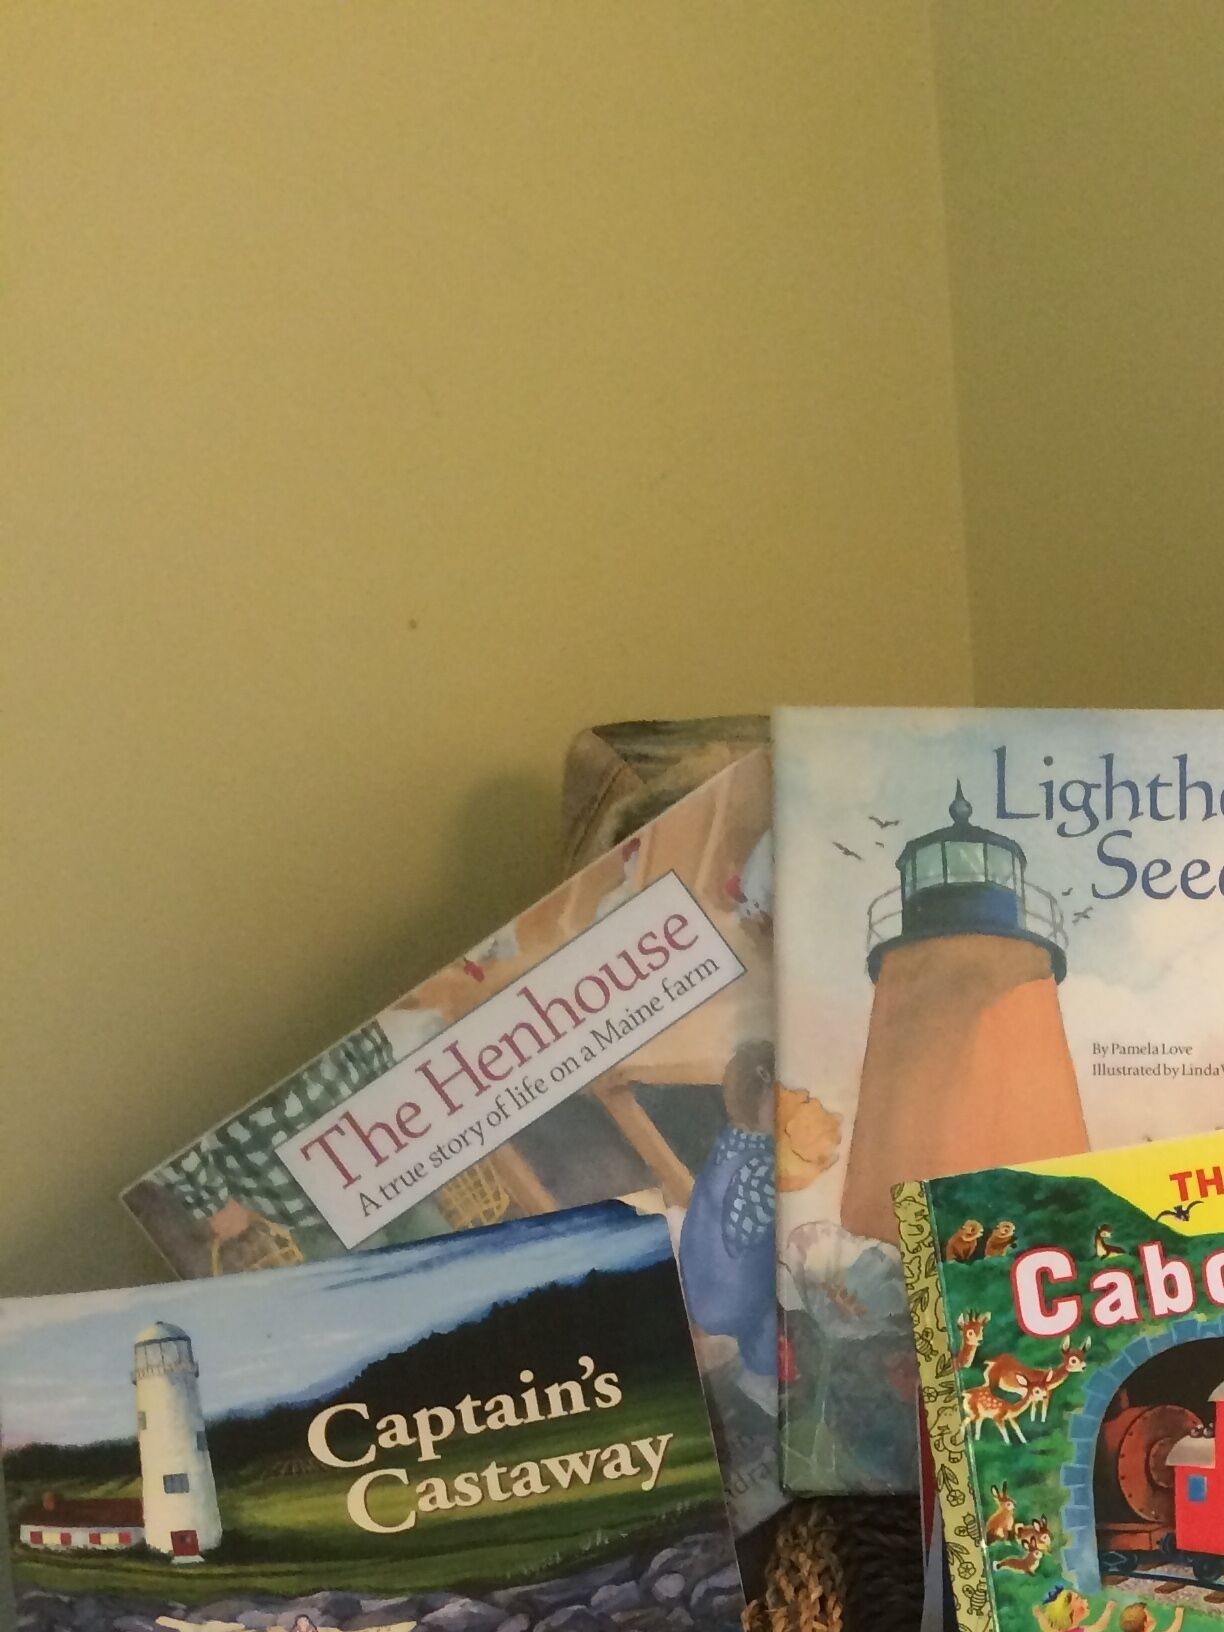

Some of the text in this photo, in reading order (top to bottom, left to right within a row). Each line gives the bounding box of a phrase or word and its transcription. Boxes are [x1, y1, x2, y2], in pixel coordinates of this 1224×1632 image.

[300, 913, 699, 1190] The Henhouse
[358, 957, 720, 1217] A true story of life on a Maine farm
[1092, 1041, 1193, 1058] By Pamela Love
[1092, 1063, 1161, 1077] Illustrated
[1163, 1063, 1180, 1079] by
[1182, 1063, 1220, 1077] Linda
[307, 1355, 623, 1468] Captain's
[346, 1432, 674, 1534] Castaway
